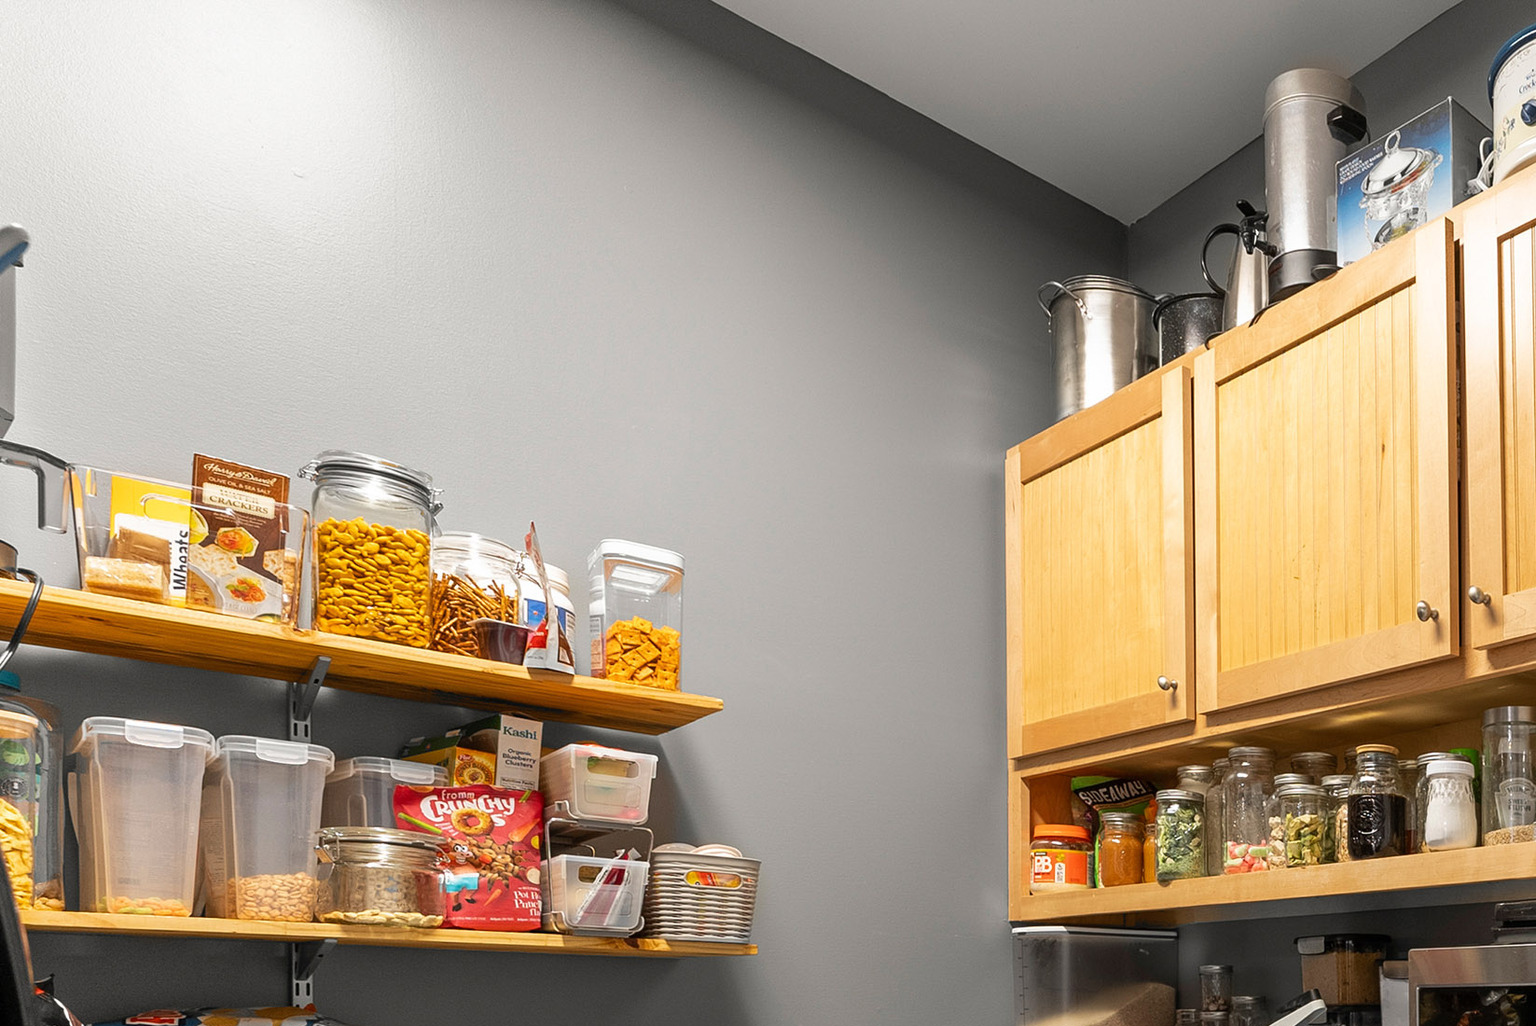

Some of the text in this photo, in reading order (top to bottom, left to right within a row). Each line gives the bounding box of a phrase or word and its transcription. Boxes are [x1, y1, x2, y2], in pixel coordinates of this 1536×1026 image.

[208, 494, 270, 515] CRACKERS
[173, 529, 189, 591] Wheats
[503, 725, 537, 740] Kashi
[502, 753, 537, 765] Blueberry
[504, 760, 534, 769] Clusters
[441, 790, 476, 800] fromm
[1078, 780, 1147, 805] SIDEAWAY
[420, 794, 516, 823] CRUNCHY
[1034, 855, 1053, 874] PB
